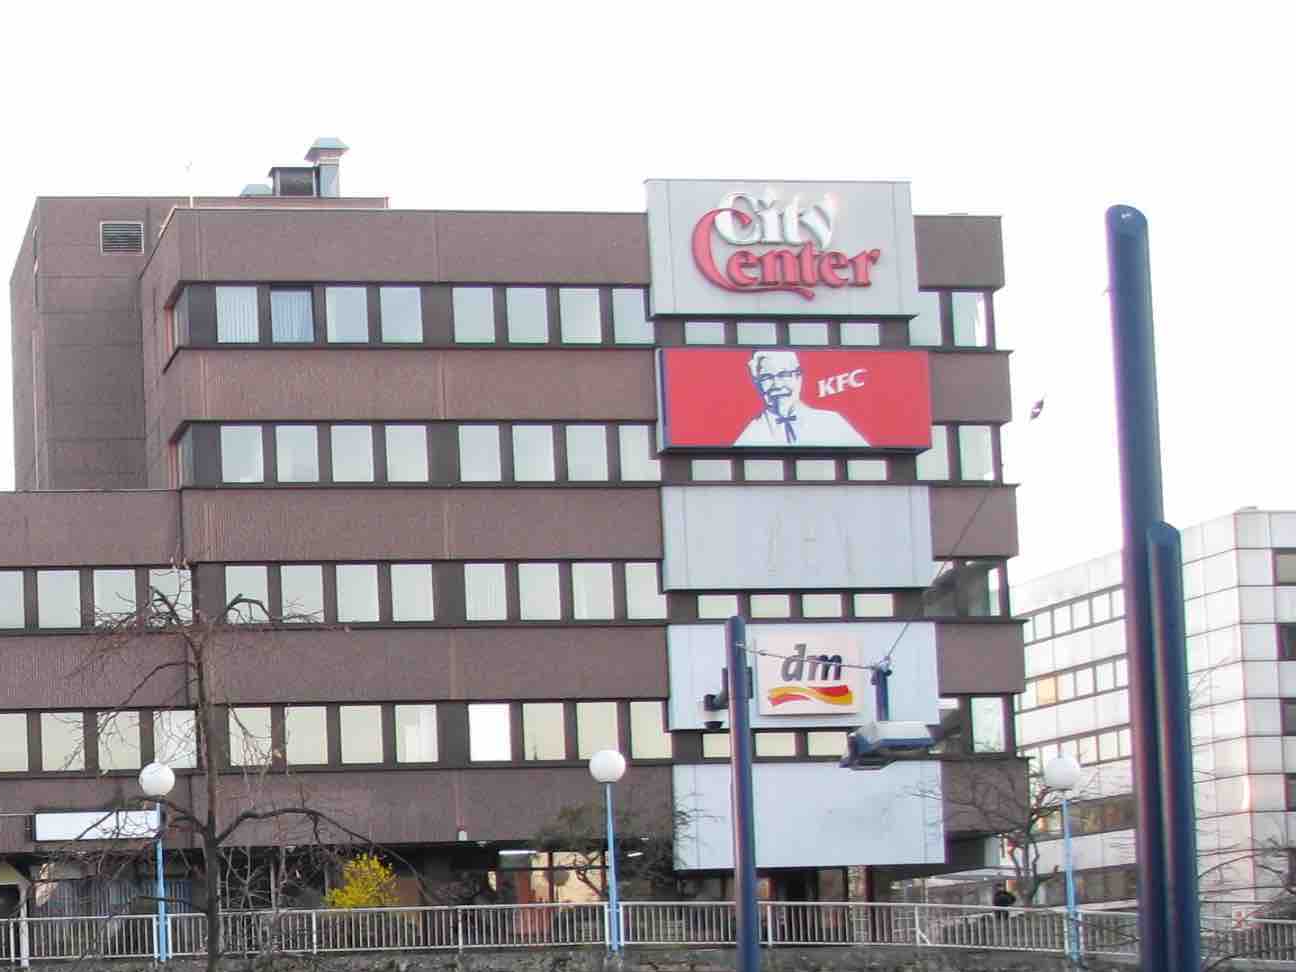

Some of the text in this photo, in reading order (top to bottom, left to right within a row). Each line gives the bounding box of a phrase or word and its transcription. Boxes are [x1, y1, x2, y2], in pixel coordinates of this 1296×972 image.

[713, 191, 838, 248] City
[691, 207, 882, 302] Center
[816, 368, 868, 397] KFC
[780, 643, 843, 683] dm
